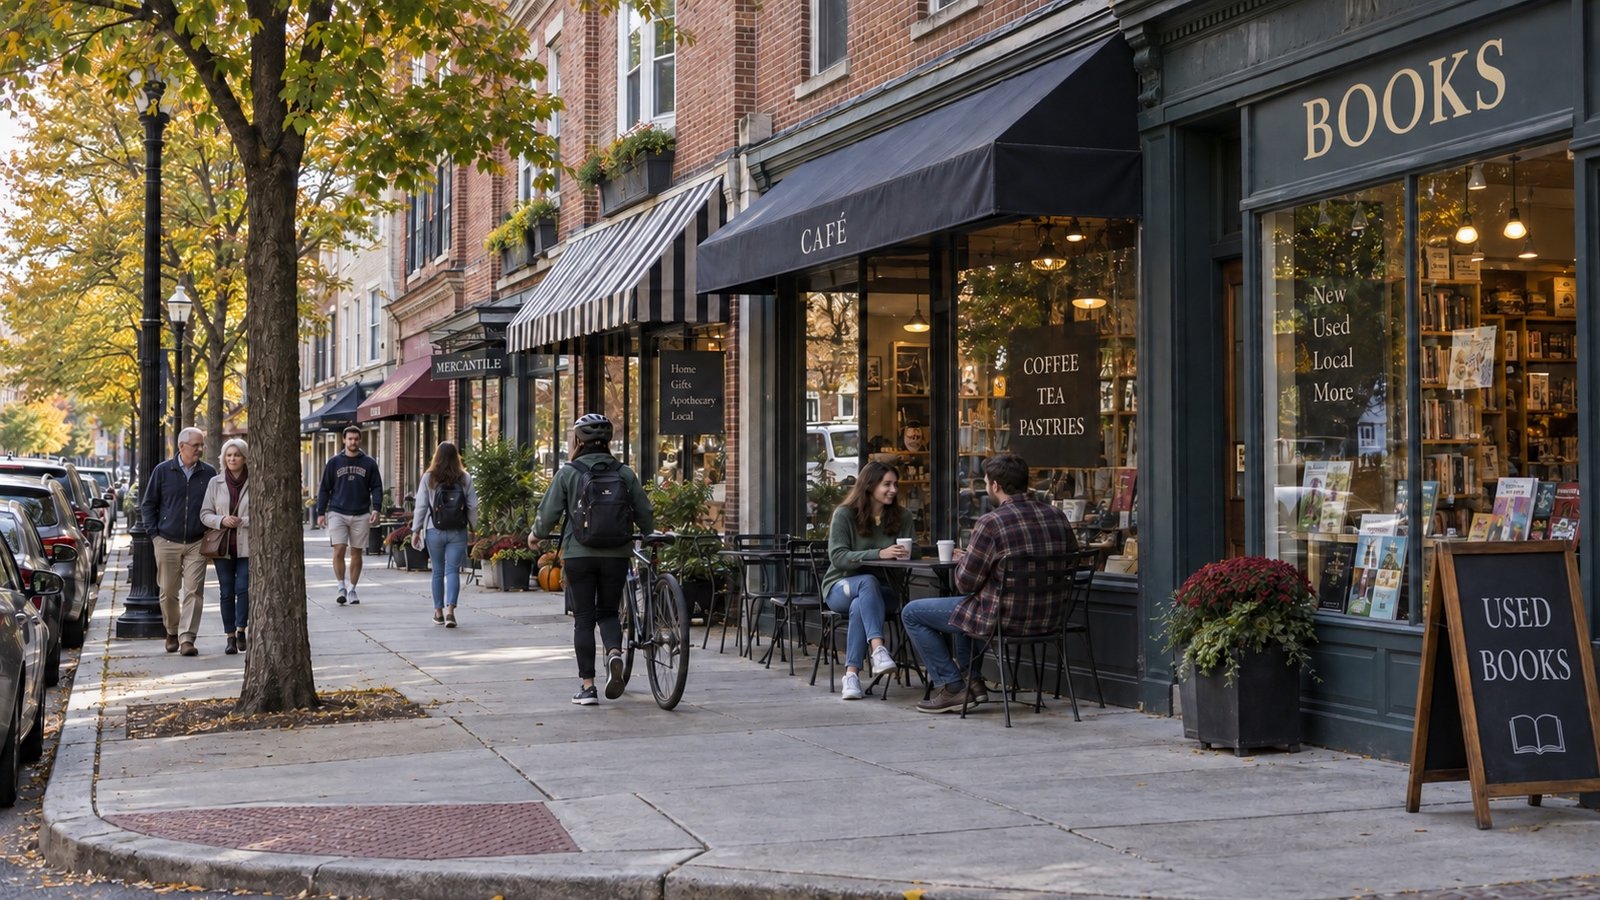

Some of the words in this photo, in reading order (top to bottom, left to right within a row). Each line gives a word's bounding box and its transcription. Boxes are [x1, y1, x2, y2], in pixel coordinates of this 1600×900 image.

[1303, 38, 1506, 160] BOOKS
[801, 211, 847, 254] CAFÉ
[1313, 285, 1347, 305] New
[1313, 313, 1351, 338] Used
[436, 358, 502, 373] MERCANTILE
[671, 363, 697, 374] Home
[1023, 354, 1079, 375] COFFEE
[1313, 347, 1354, 370] Local
[670, 379, 692, 389] Gifts
[1313, 382, 1354, 402] More
[670, 395, 717, 408] Apothecary
[1037, 386, 1065, 405] TEA
[671, 411, 694, 421] Local
[1019, 417, 1085, 436] PASTRIES
[1481, 596, 1551, 629] USED
[1479, 648, 1571, 681] BOOKS
